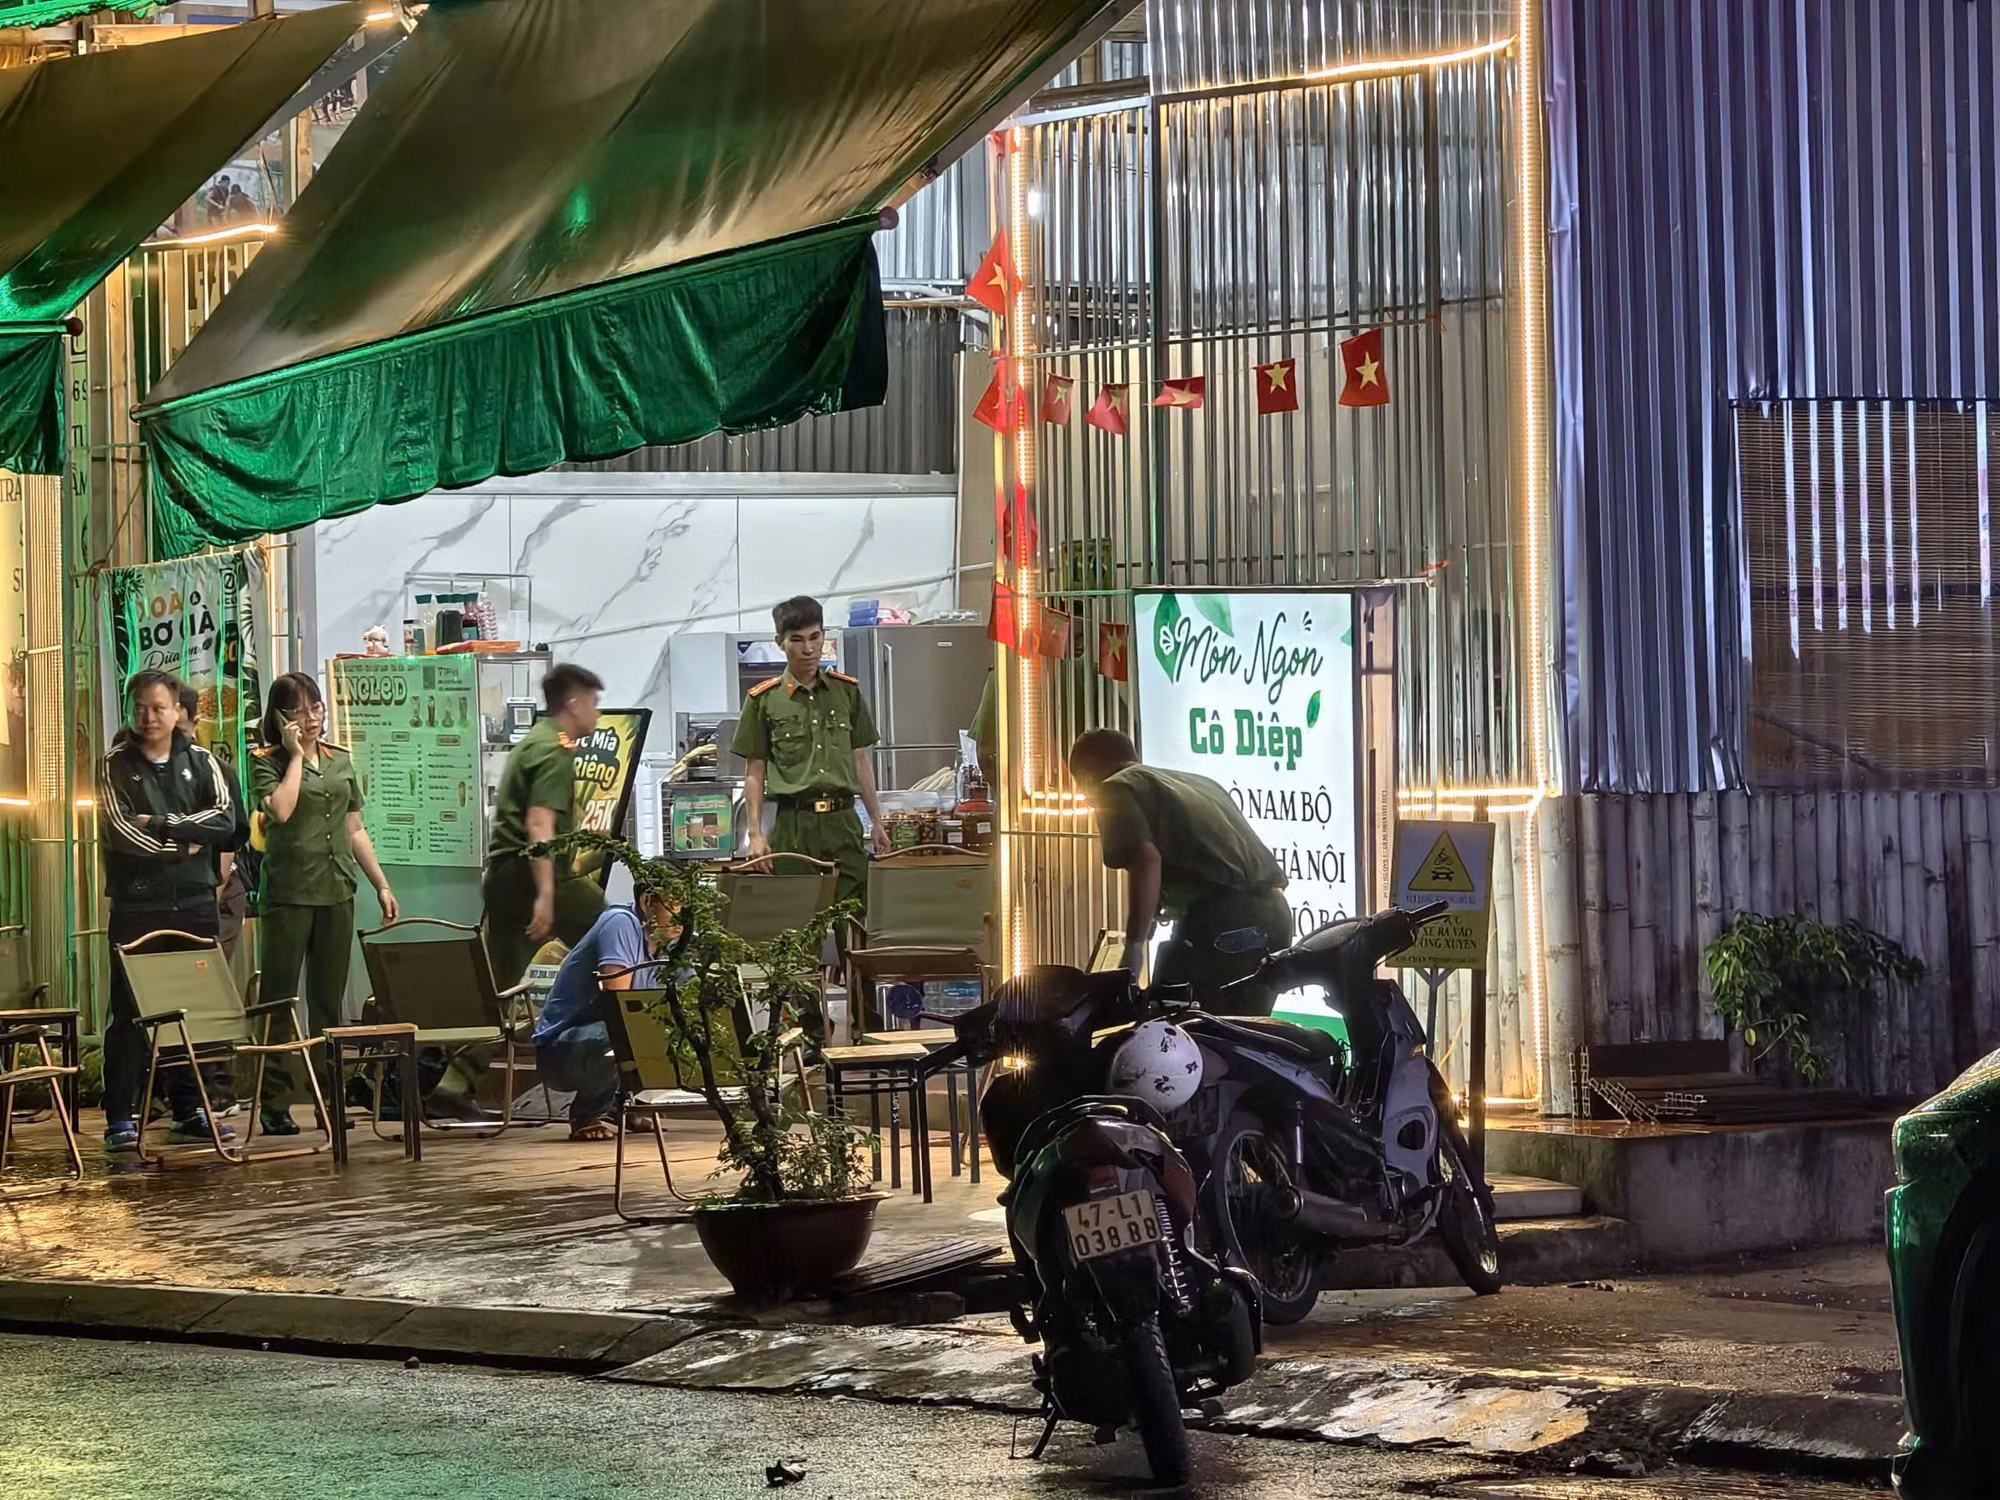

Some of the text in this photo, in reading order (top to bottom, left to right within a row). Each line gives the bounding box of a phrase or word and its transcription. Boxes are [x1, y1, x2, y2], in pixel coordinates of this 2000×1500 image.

[139, 620, 173, 651] BƠ
[1175, 611, 1324, 705] Món Ngon
[590, 729, 617, 752] Mía
[1189, 707, 1303, 772] Cô Diệp
[580, 799, 618, 831] 25K
[1247, 788, 1298, 822] NAM
[1301, 784, 1332, 831] BỘ
[1307, 843, 1346, 889] NỘI
